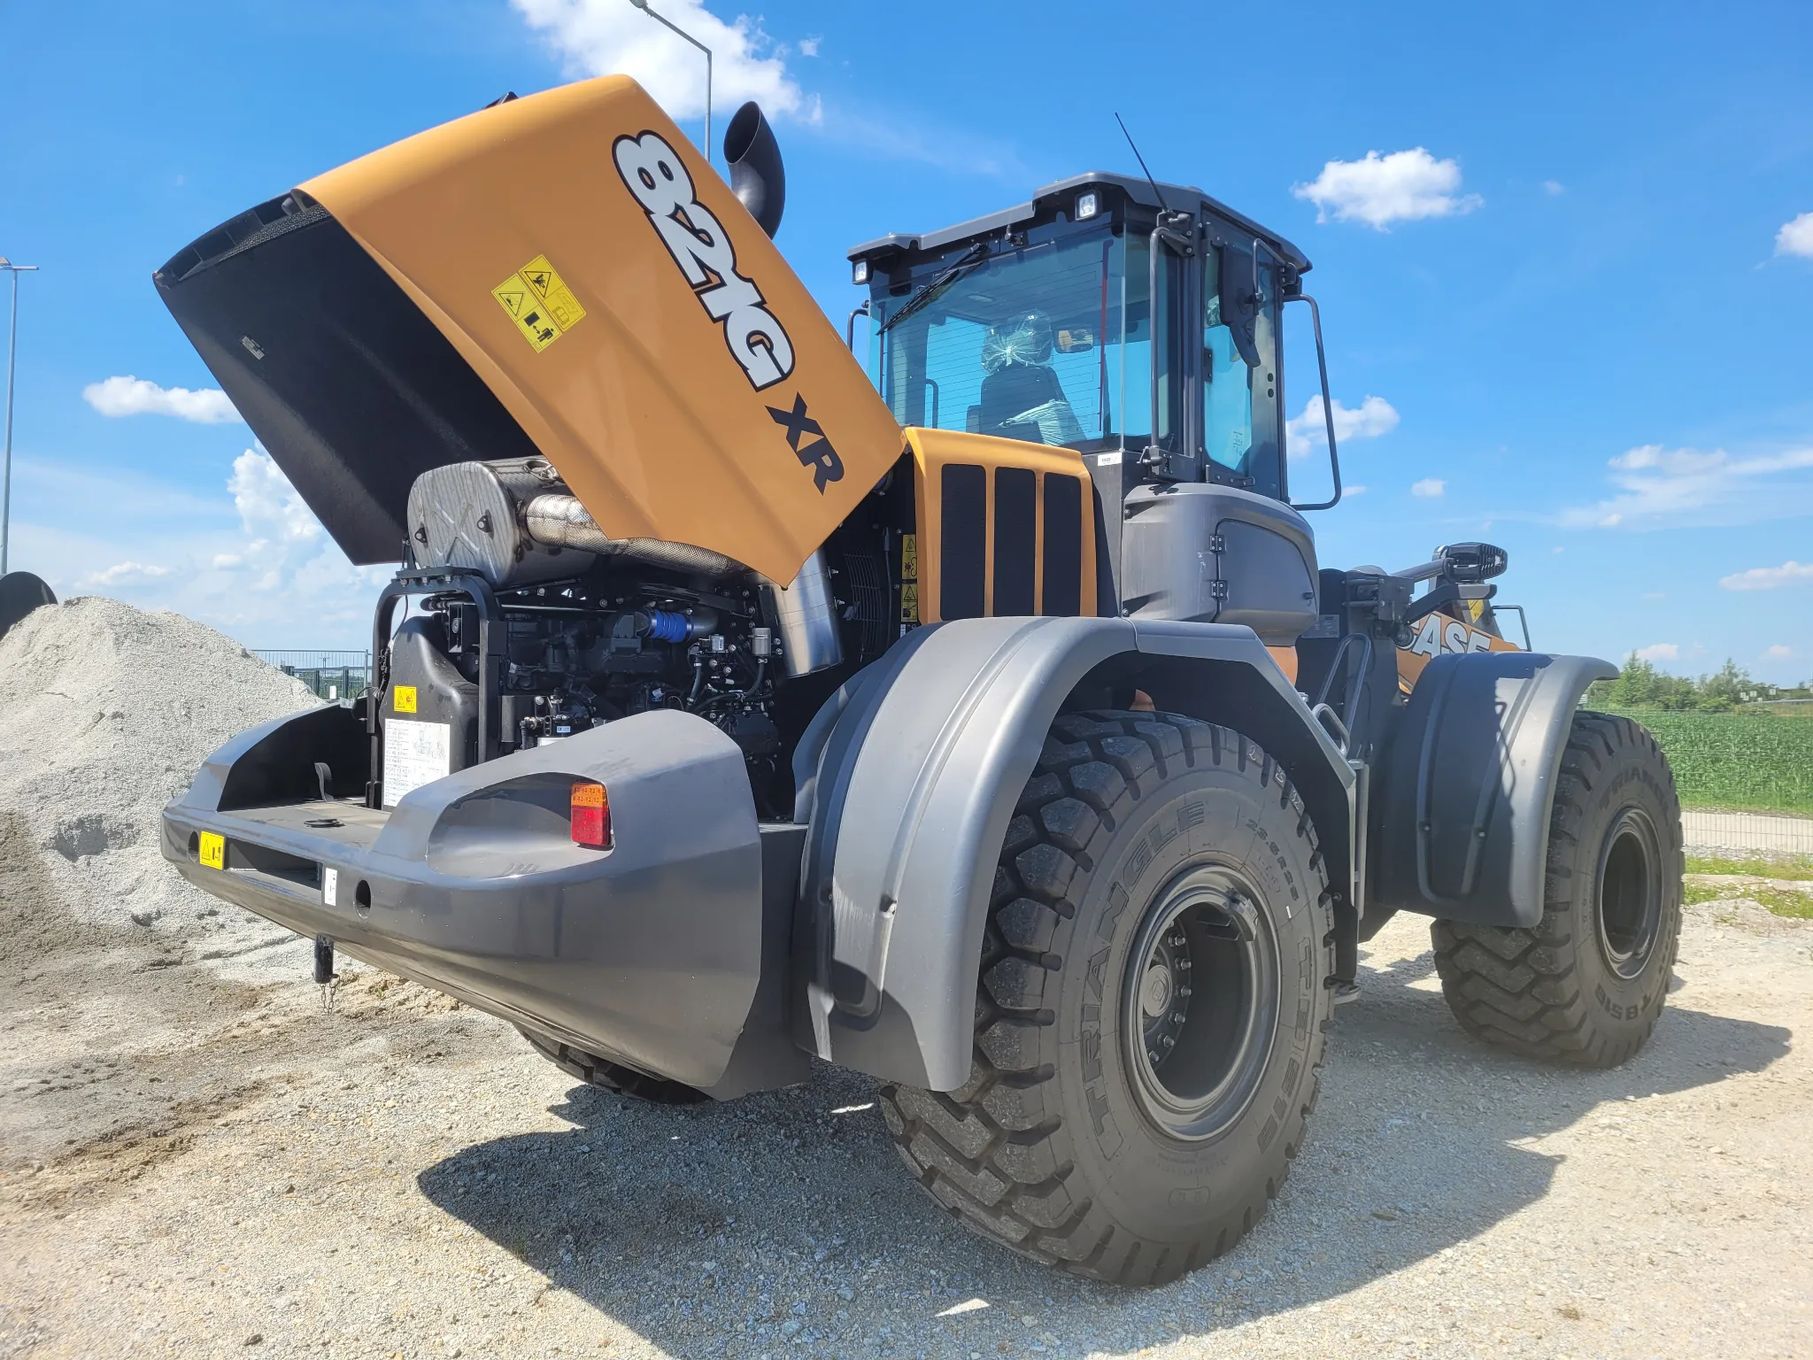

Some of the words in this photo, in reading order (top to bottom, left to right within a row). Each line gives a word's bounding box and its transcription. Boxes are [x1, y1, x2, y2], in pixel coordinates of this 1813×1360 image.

[611, 129, 796, 392] 821G
[764, 391, 845, 496] XR
[1080, 800, 1206, 1138] TRIANGLE
